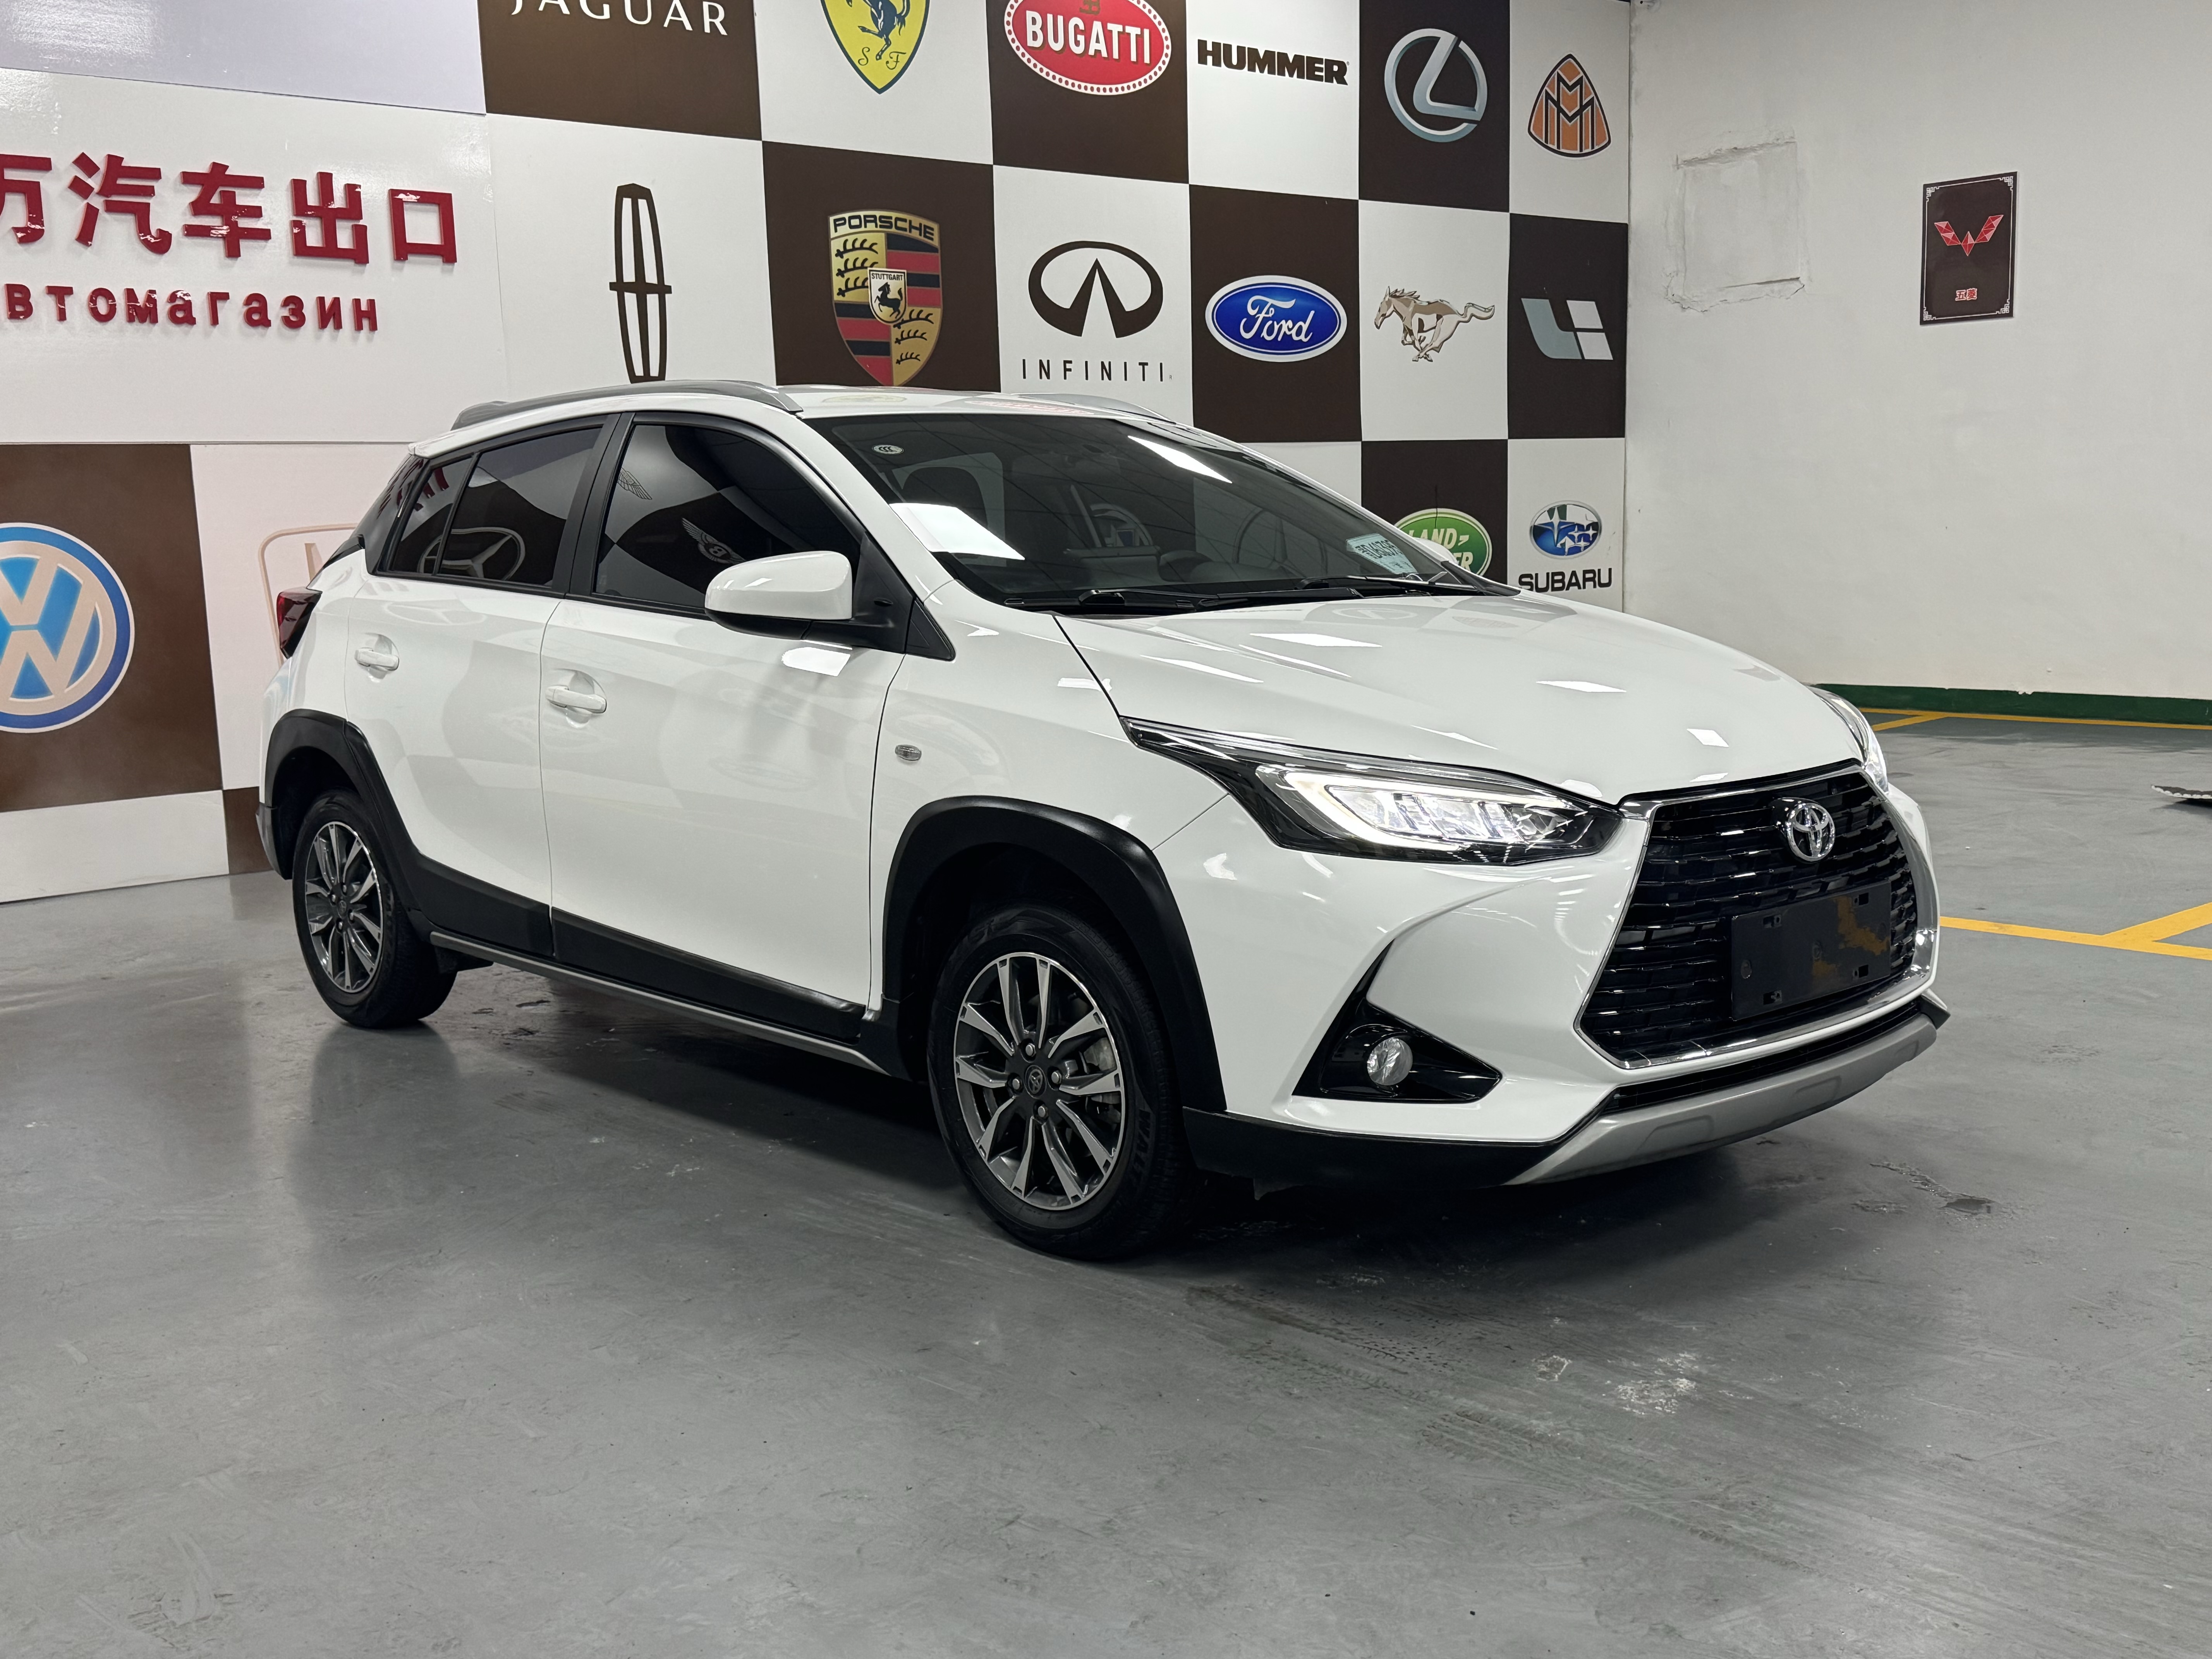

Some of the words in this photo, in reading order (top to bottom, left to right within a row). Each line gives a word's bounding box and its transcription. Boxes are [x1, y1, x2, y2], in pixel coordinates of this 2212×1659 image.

[1026, 10, 1150, 64] BUGATTI
[1198, 39, 1348, 85] HUMMER
[833, 215, 934, 241] PORSCHE
[1240, 295, 1314, 342] Ford
[1023, 359, 1163, 382] INFINITI
[1518, 568, 1612, 592] SUBARU
